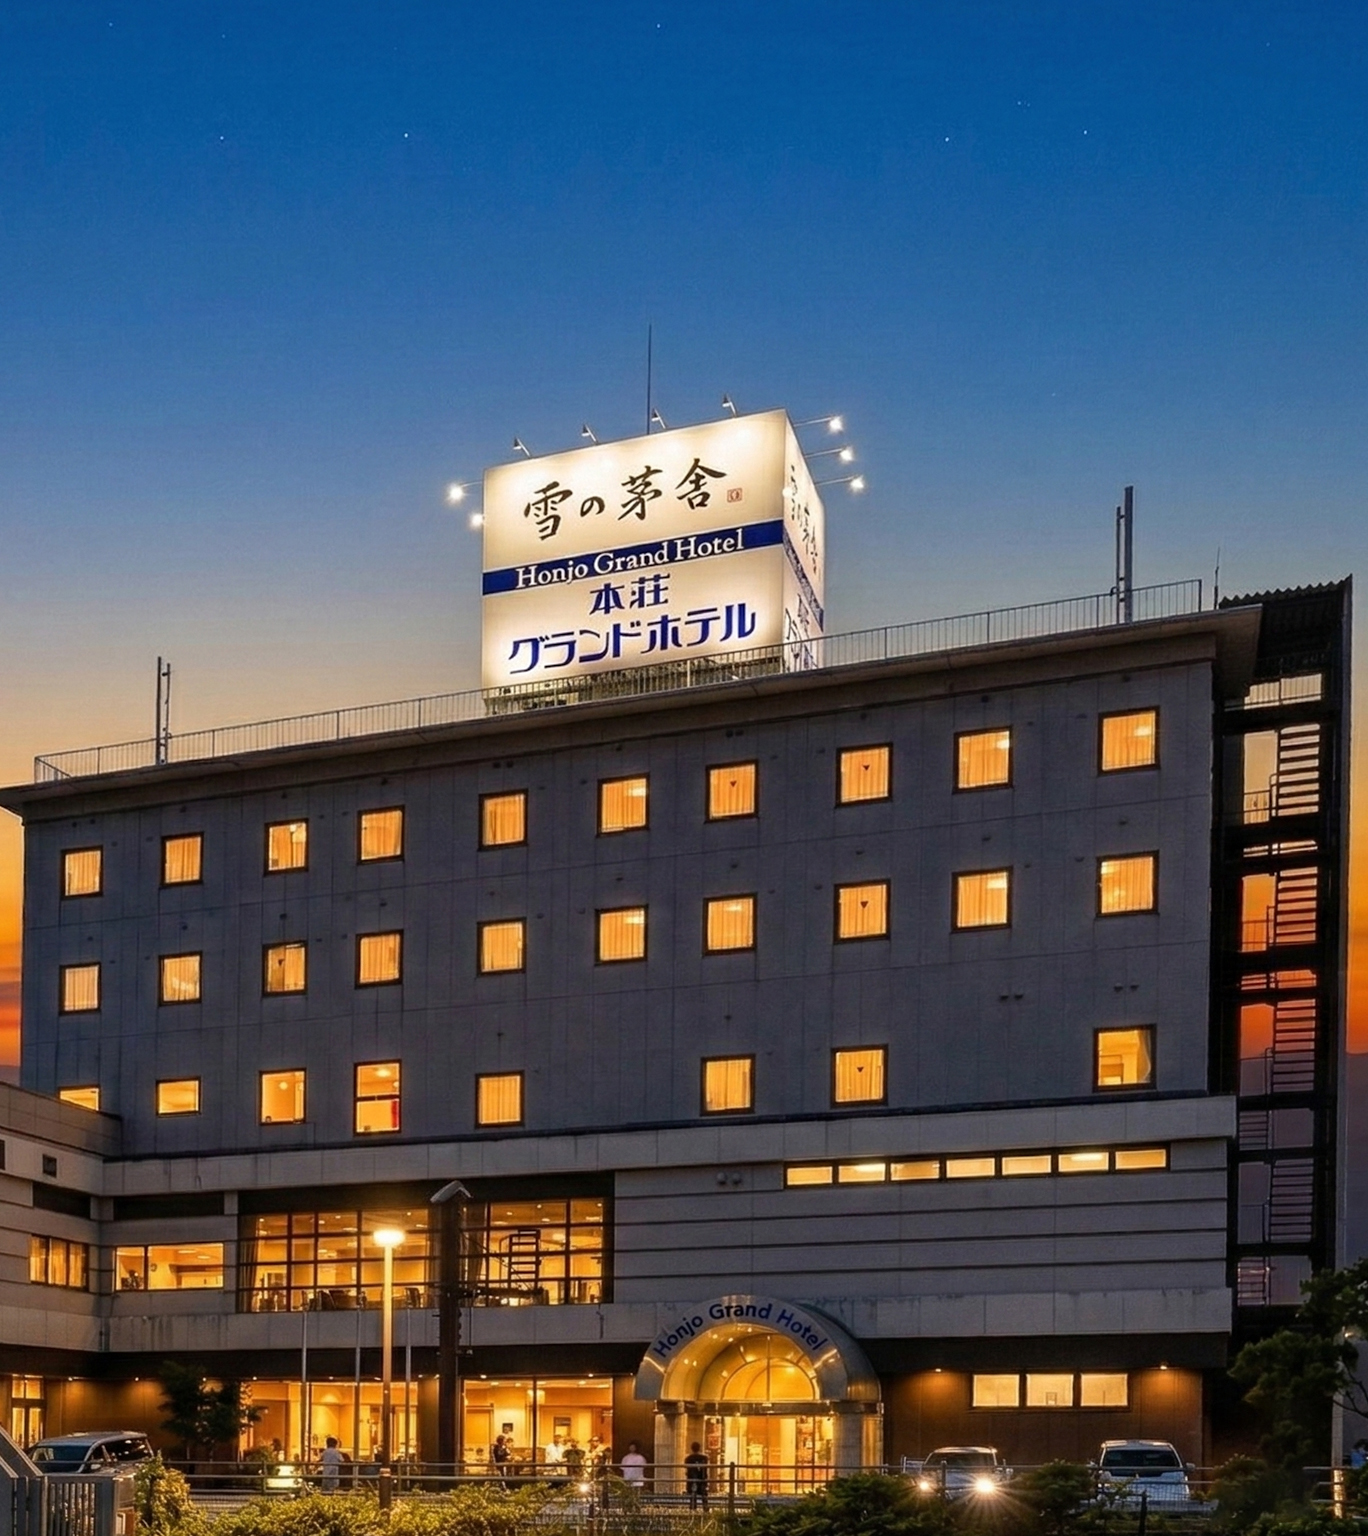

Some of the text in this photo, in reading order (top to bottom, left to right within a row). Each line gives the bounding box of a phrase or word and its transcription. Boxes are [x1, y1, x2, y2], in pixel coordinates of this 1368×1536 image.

[524, 458, 726, 541] 雪の茅舎
[515, 528, 745, 589] Honjo Grand Hotel
[589, 573, 671, 615] 本荘
[508, 602, 756, 675] グランドホテル
[653, 1303, 828, 1358] Honjo Grand Hotel
